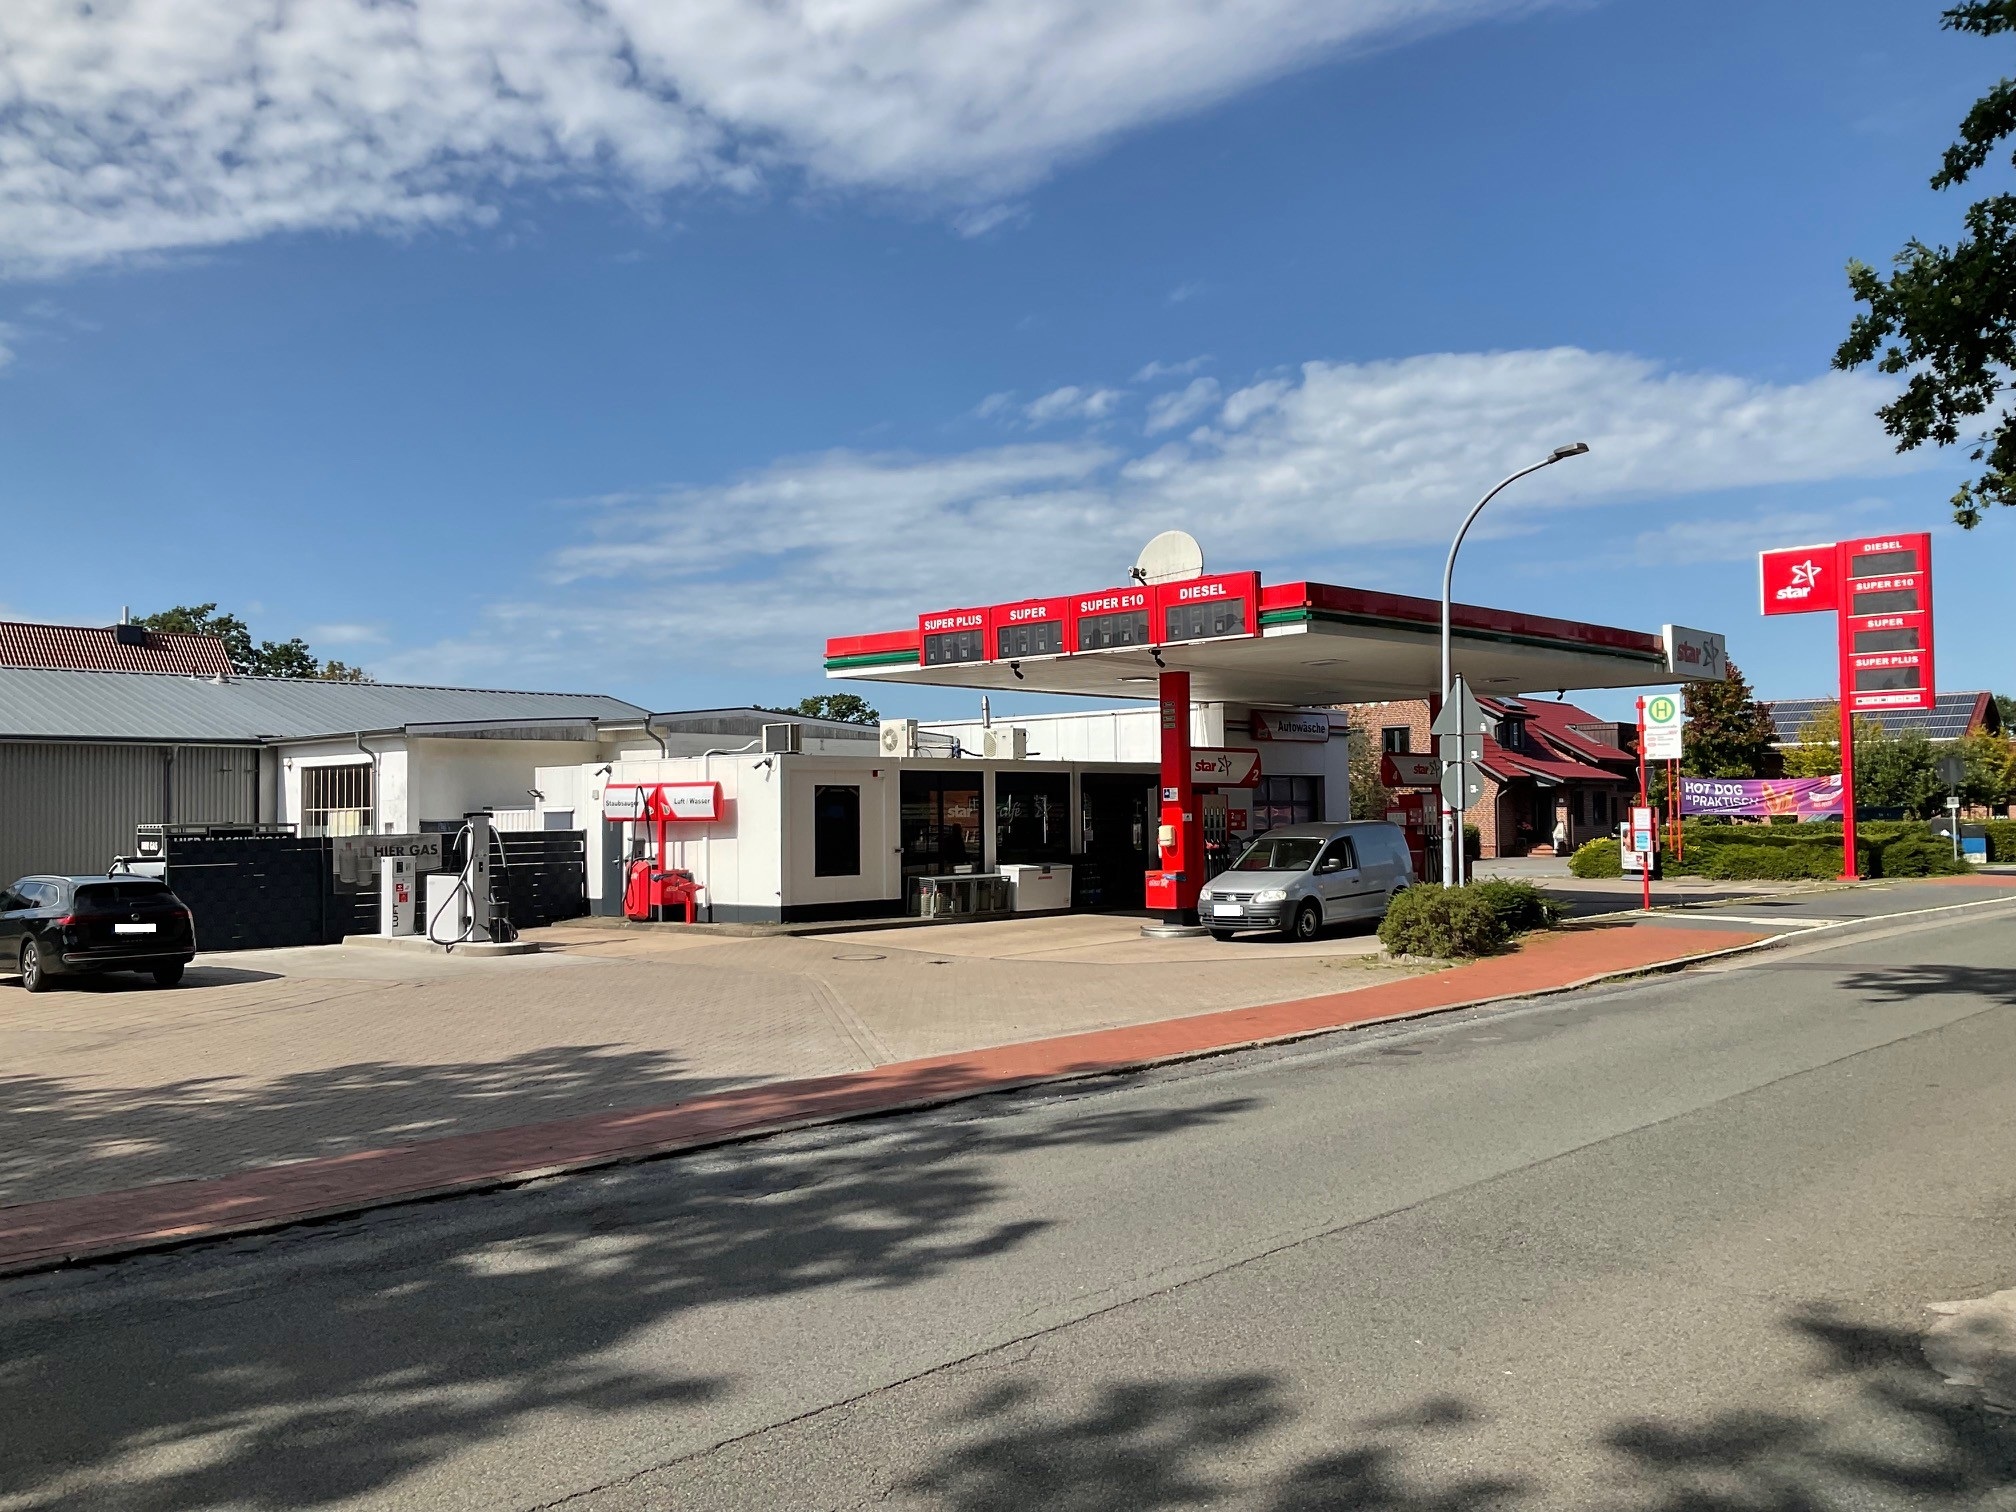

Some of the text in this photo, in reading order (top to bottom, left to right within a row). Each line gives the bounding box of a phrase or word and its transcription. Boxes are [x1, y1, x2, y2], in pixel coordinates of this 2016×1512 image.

[1864, 541, 1903, 551] DIESEL
[1180, 583, 1227, 600] DIESEL
[1856, 578, 1914, 591] SUPER E10
[1776, 585, 1811, 600] star
[1080, 594, 1144, 613] SUPER E10
[1009, 606, 1046, 621] SUPER
[924, 614, 982, 631] SUPER PLUS
[1867, 618, 1904, 628] SUPER
[1677, 641, 1702, 664] star
[1856, 655, 1919, 667] SUPER PLUS
[1656, 702, 1667, 717] H
[1277, 720, 1326, 734] Autowäsche
[1194, 759, 1216, 772] star
[1413, 763, 1430, 774] star
[1252, 769, 1259, 781] 2
[1684, 781, 1743, 796] HOT DOG
[1692, 795, 1760, 807] PRAKTISCH
[947, 804, 973, 818] star
[373, 843, 438, 858] HIER GAS
